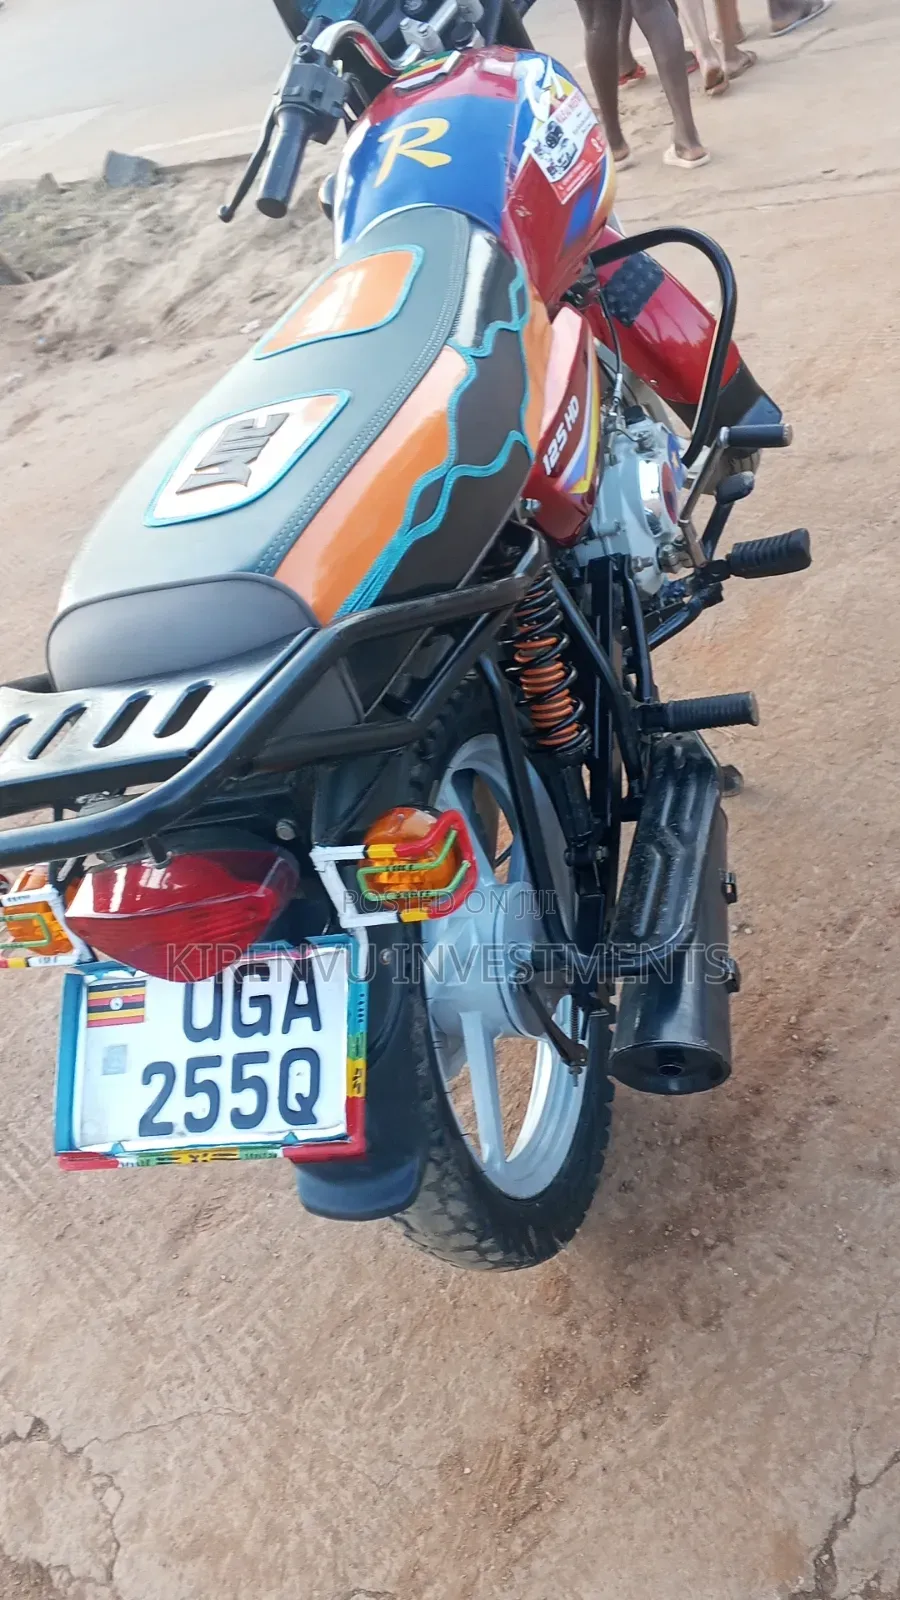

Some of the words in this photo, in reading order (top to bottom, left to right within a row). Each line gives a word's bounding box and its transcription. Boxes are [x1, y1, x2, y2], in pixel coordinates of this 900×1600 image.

[373, 117, 452, 188] R
[543, 422, 568, 475] 125
[564, 395, 579, 431] HD
[182, 955, 322, 1042] UGA
[138, 1047, 321, 1137] 255Q
